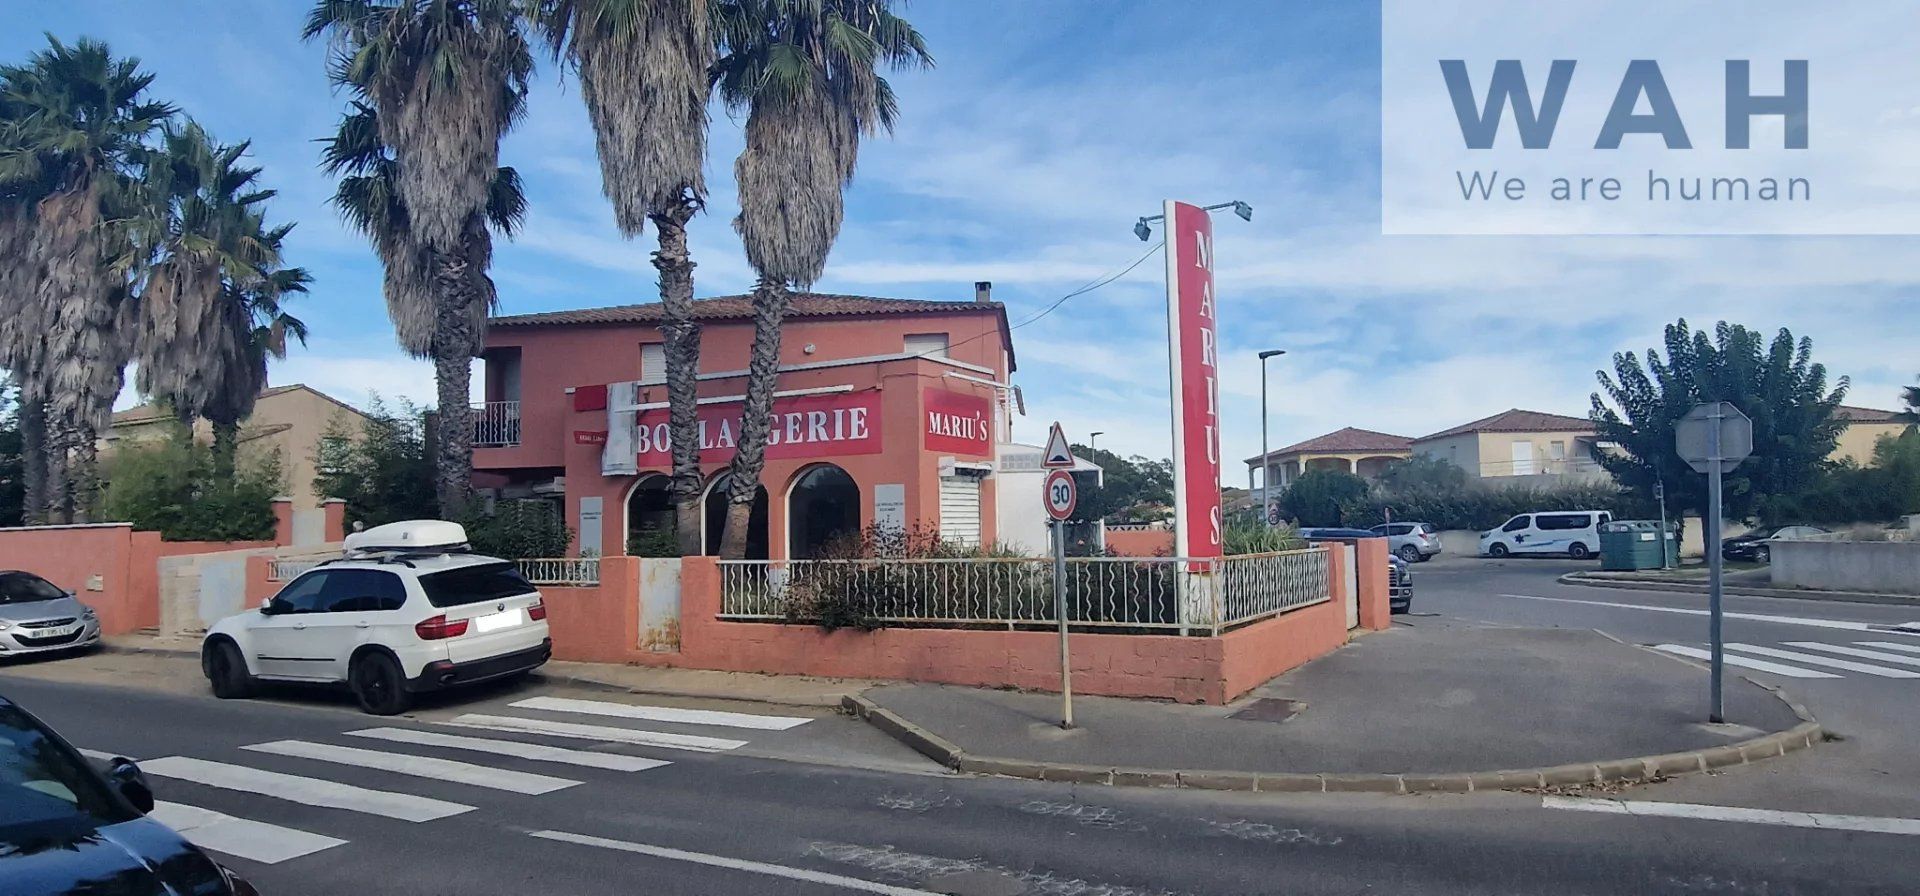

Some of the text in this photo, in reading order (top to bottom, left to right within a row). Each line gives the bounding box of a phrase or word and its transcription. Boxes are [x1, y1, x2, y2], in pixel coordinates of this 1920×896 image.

[1194, 229, 1220, 546] MARIU'S
[636, 406, 869, 455] BOLAGERIE
[928, 409, 988, 442] MARIU'S
[1052, 484, 1070, 505] 30
